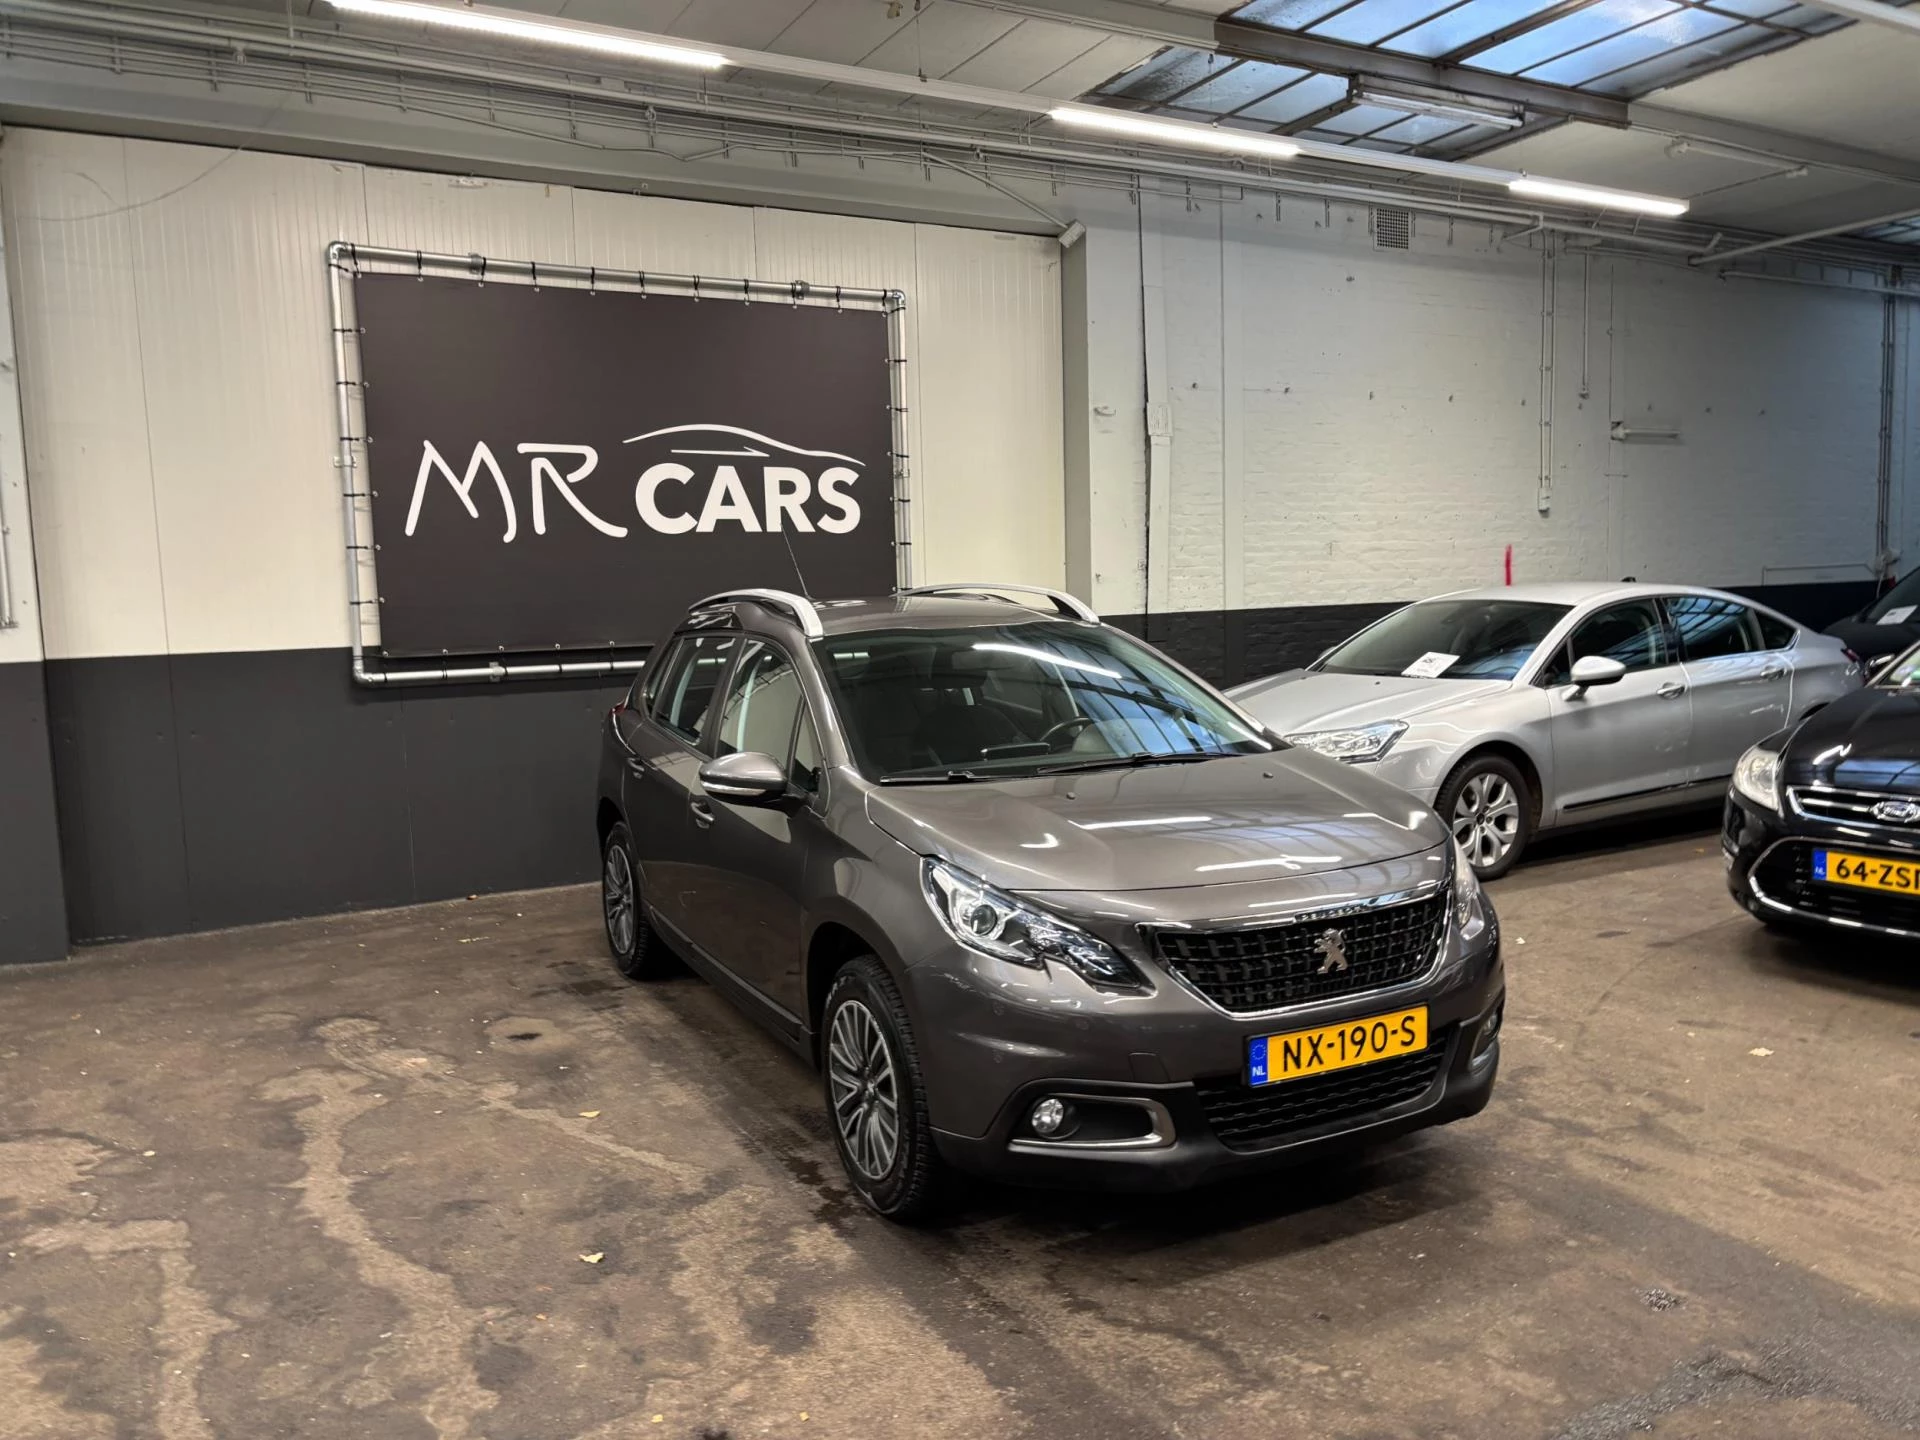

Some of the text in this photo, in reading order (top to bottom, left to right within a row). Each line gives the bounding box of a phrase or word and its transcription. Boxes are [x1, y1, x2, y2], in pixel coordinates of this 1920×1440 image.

[404, 439, 862, 544] MR CARS
[1251, 1065, 1267, 1077] NL
[1282, 1015, 1416, 1073] NX-190-S
